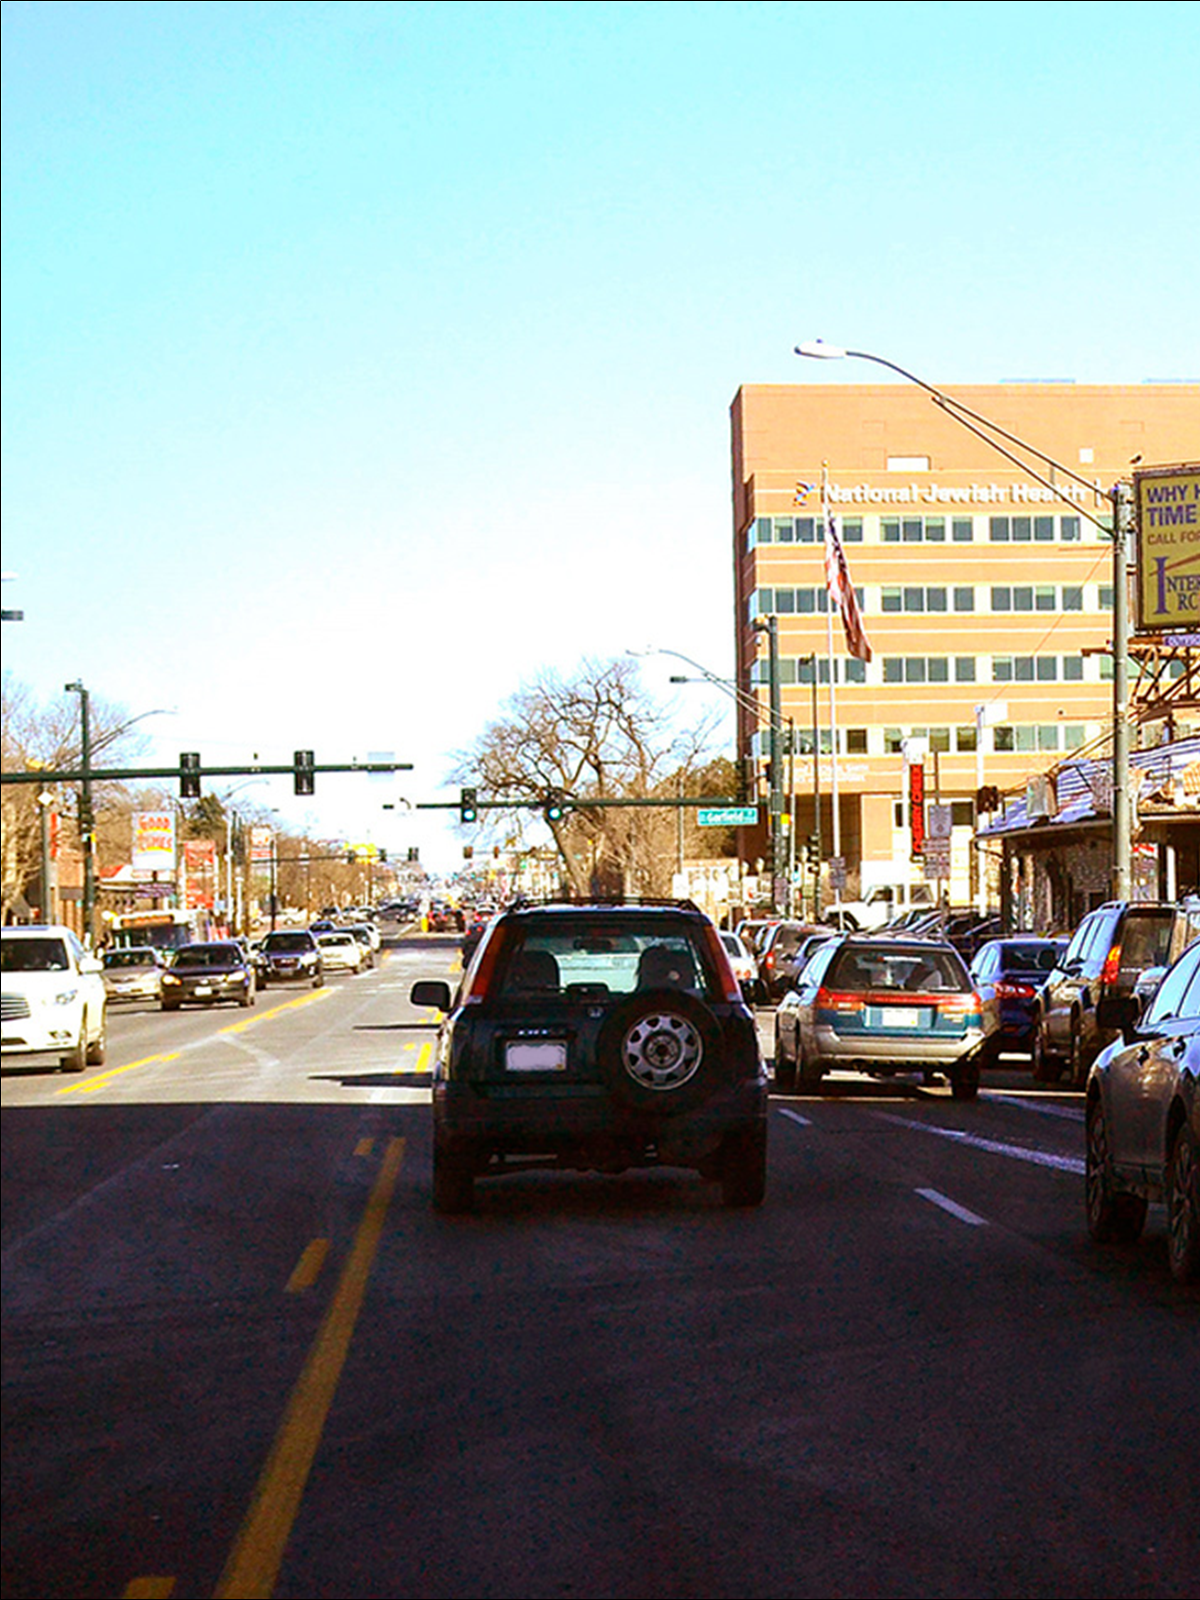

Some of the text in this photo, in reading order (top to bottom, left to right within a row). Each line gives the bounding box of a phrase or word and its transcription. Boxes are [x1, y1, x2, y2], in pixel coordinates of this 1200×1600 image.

[823, 482, 1086, 503] National Jewish Health
[1147, 485, 1188, 504] WHY
[1147, 504, 1197, 527] TIME
[1147, 533, 1177, 546] CALL
